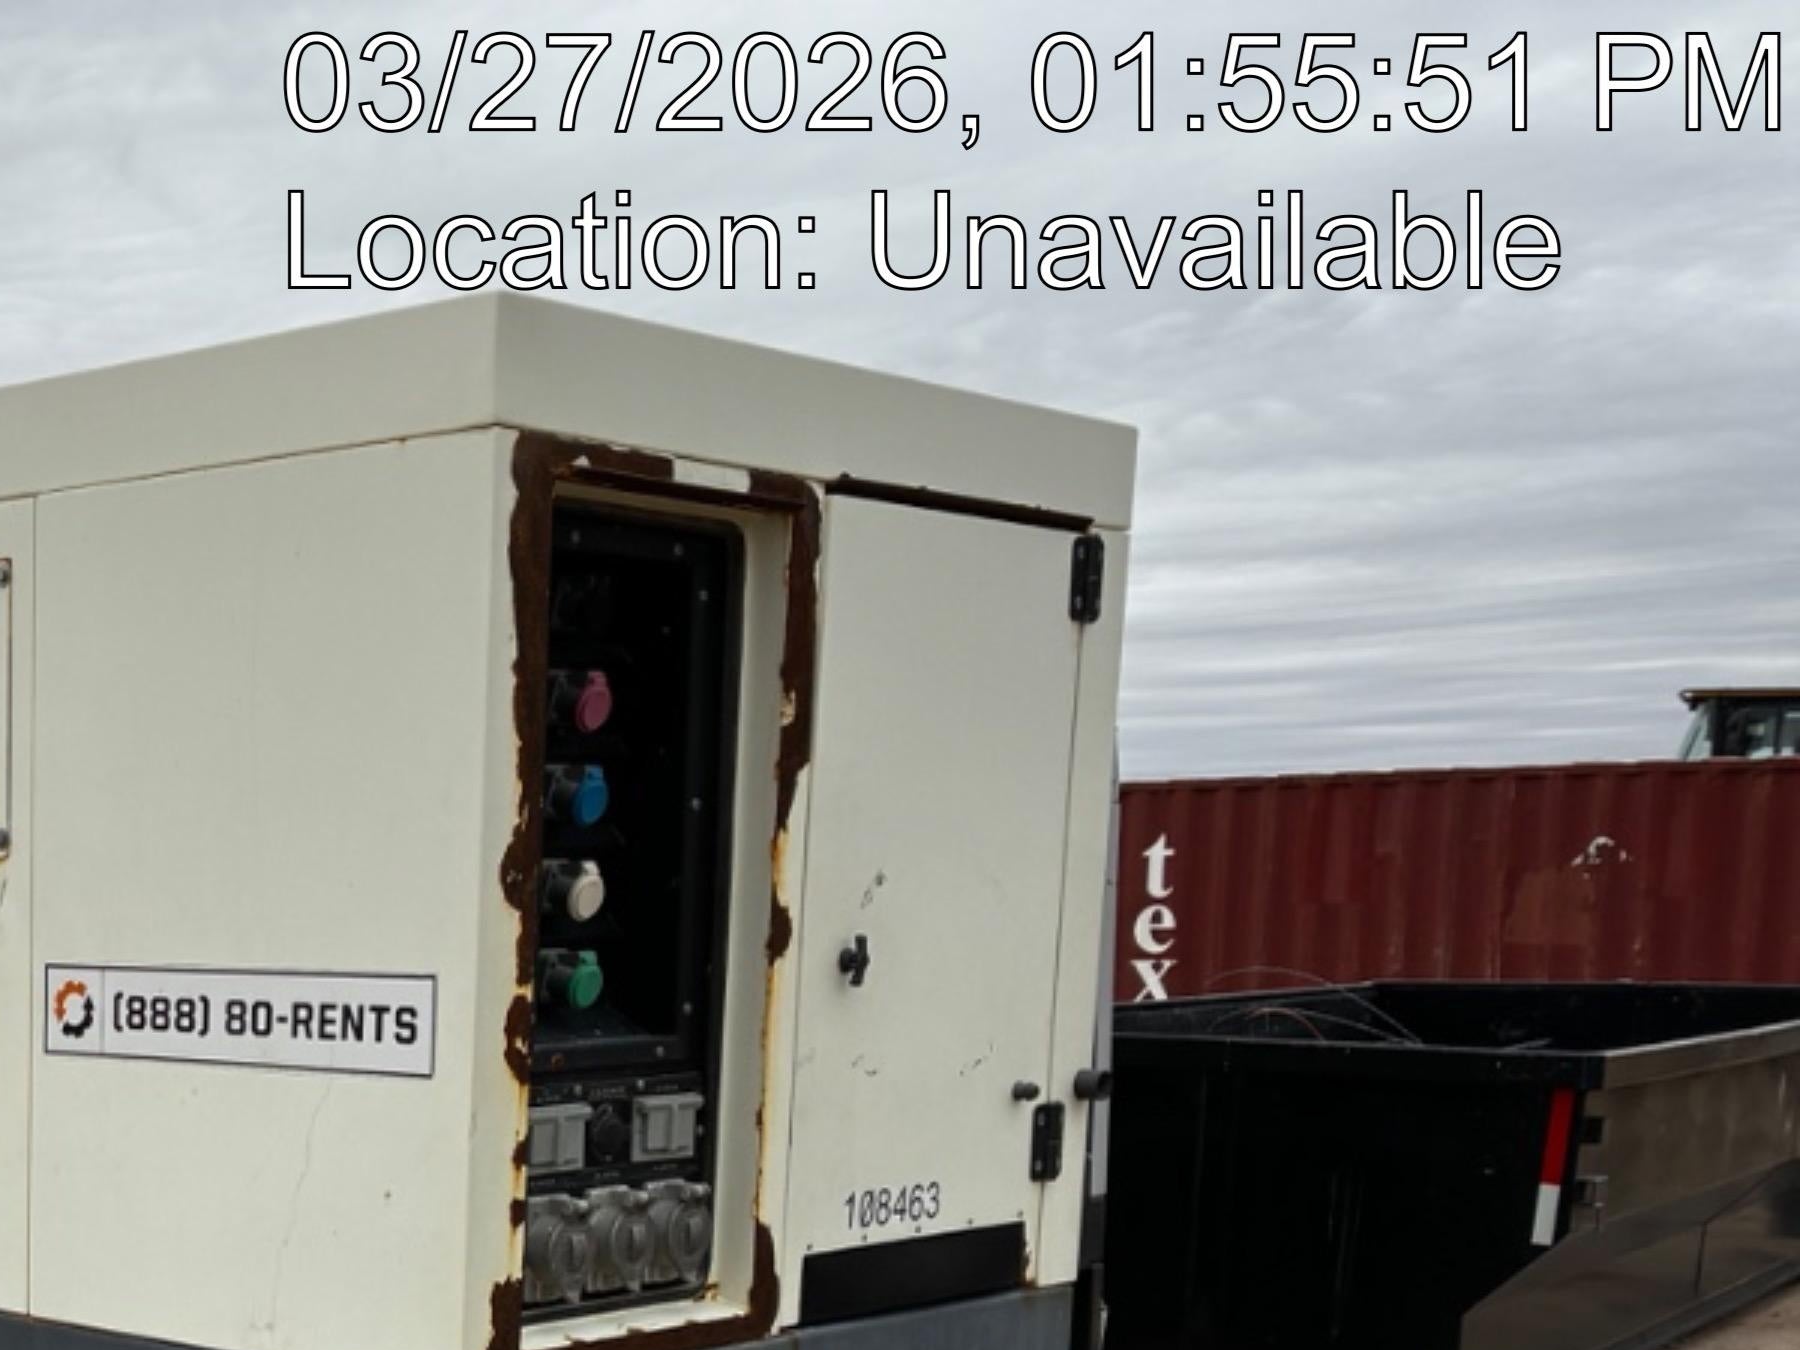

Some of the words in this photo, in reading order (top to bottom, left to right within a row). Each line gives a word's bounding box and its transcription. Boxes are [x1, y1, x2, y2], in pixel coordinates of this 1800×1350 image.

[113, 990, 211, 1037] (888)
[224, 997, 419, 1046] 80-RENTS
[844, 1180, 941, 1230] 108463
